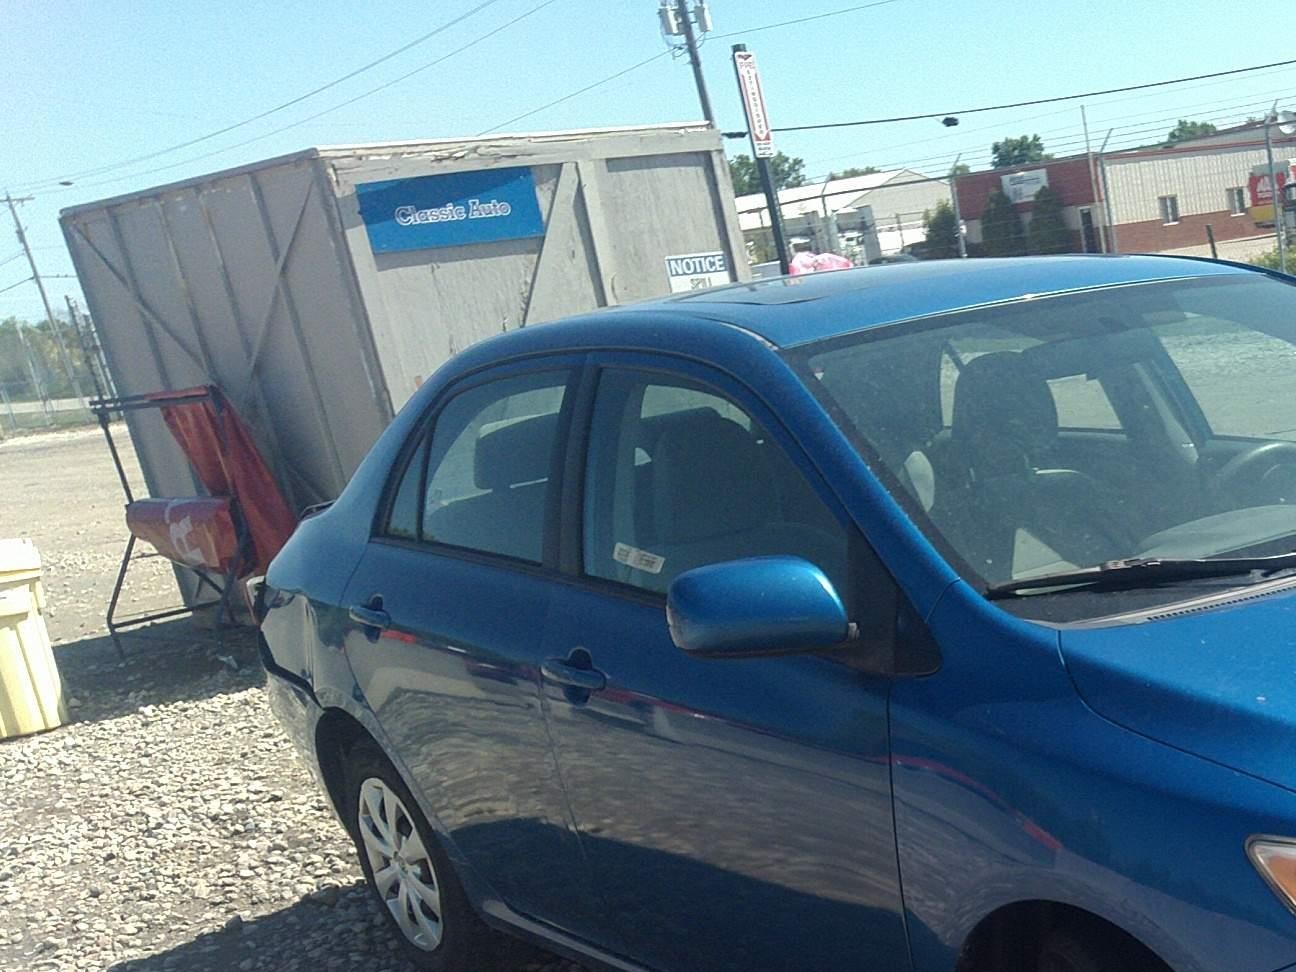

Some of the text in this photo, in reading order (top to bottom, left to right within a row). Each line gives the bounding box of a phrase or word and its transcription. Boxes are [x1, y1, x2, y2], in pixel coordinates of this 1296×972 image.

[395, 199, 511, 226] Classic Auto
[670, 255, 725, 275] NOTICE
